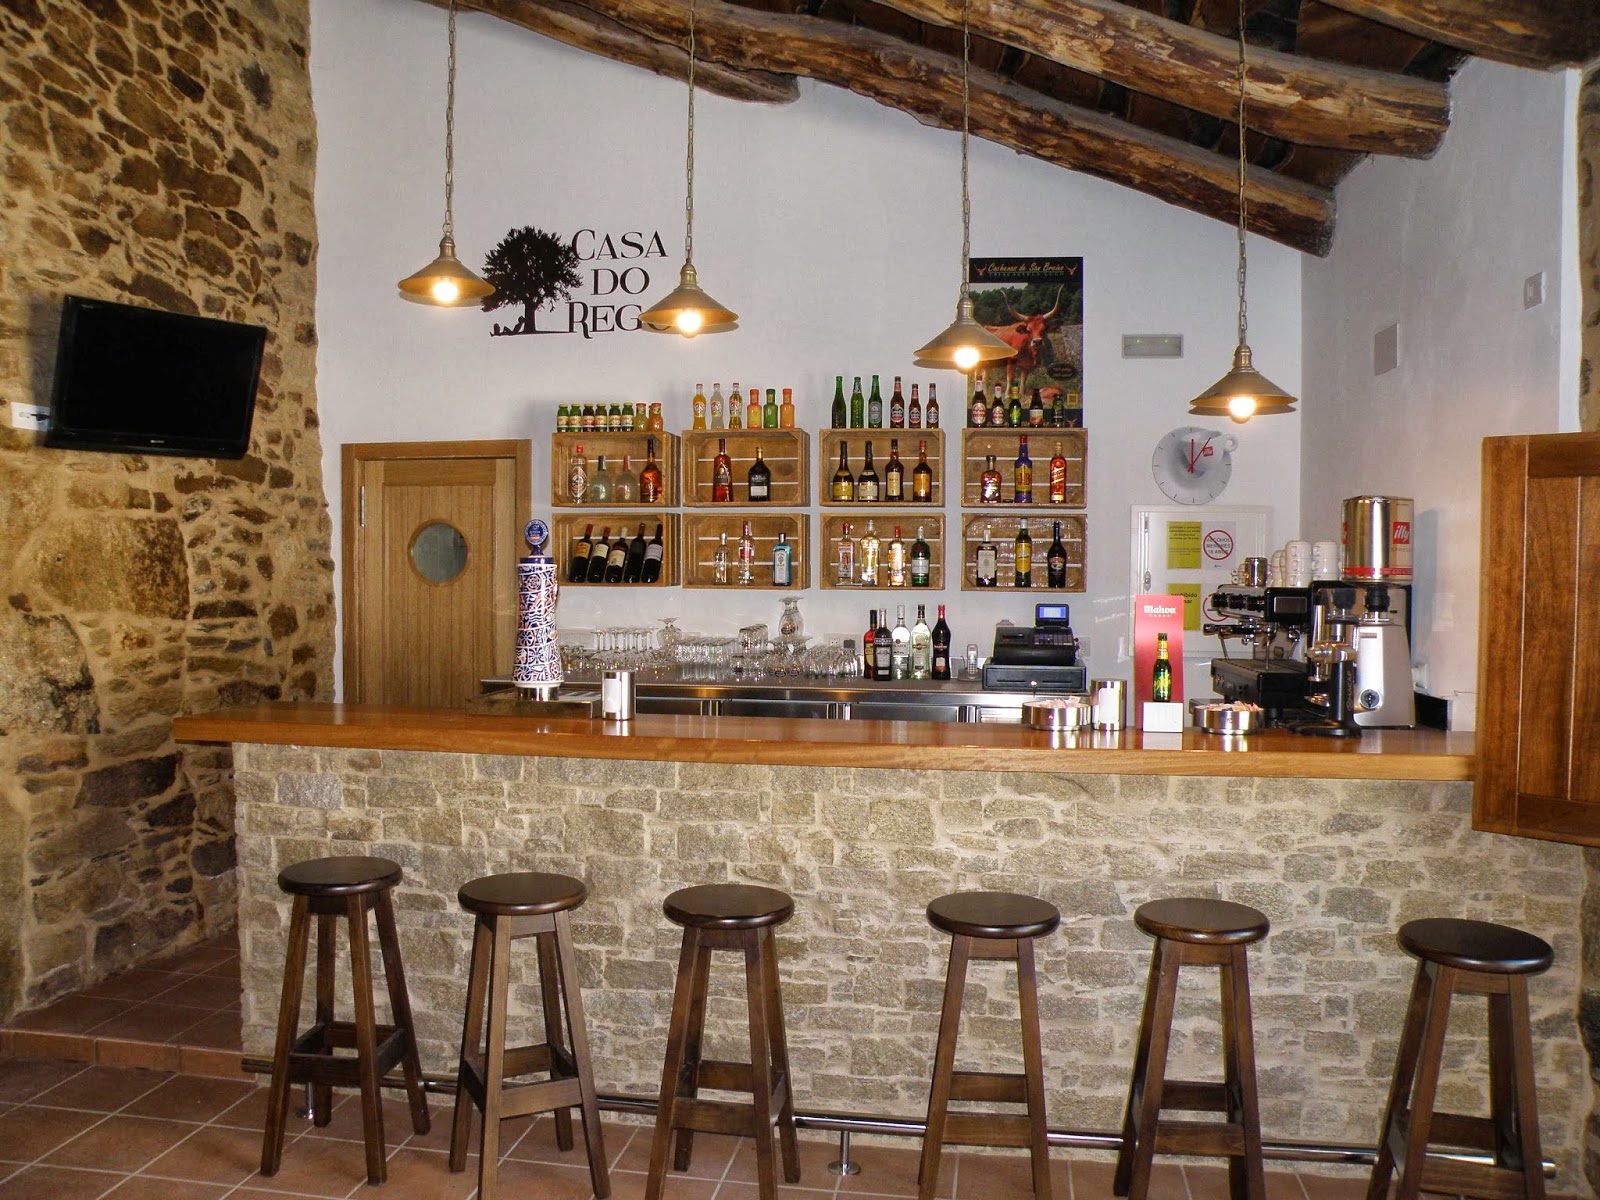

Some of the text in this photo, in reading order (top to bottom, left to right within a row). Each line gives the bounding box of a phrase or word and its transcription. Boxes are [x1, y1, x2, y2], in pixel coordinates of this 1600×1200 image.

[571, 229, 668, 261] CASA
[591, 266, 650, 295] DO
[566, 301, 672, 339] REG
[1394, 525, 1410, 543] illy
[1143, 605, 1176, 614] Mahou
